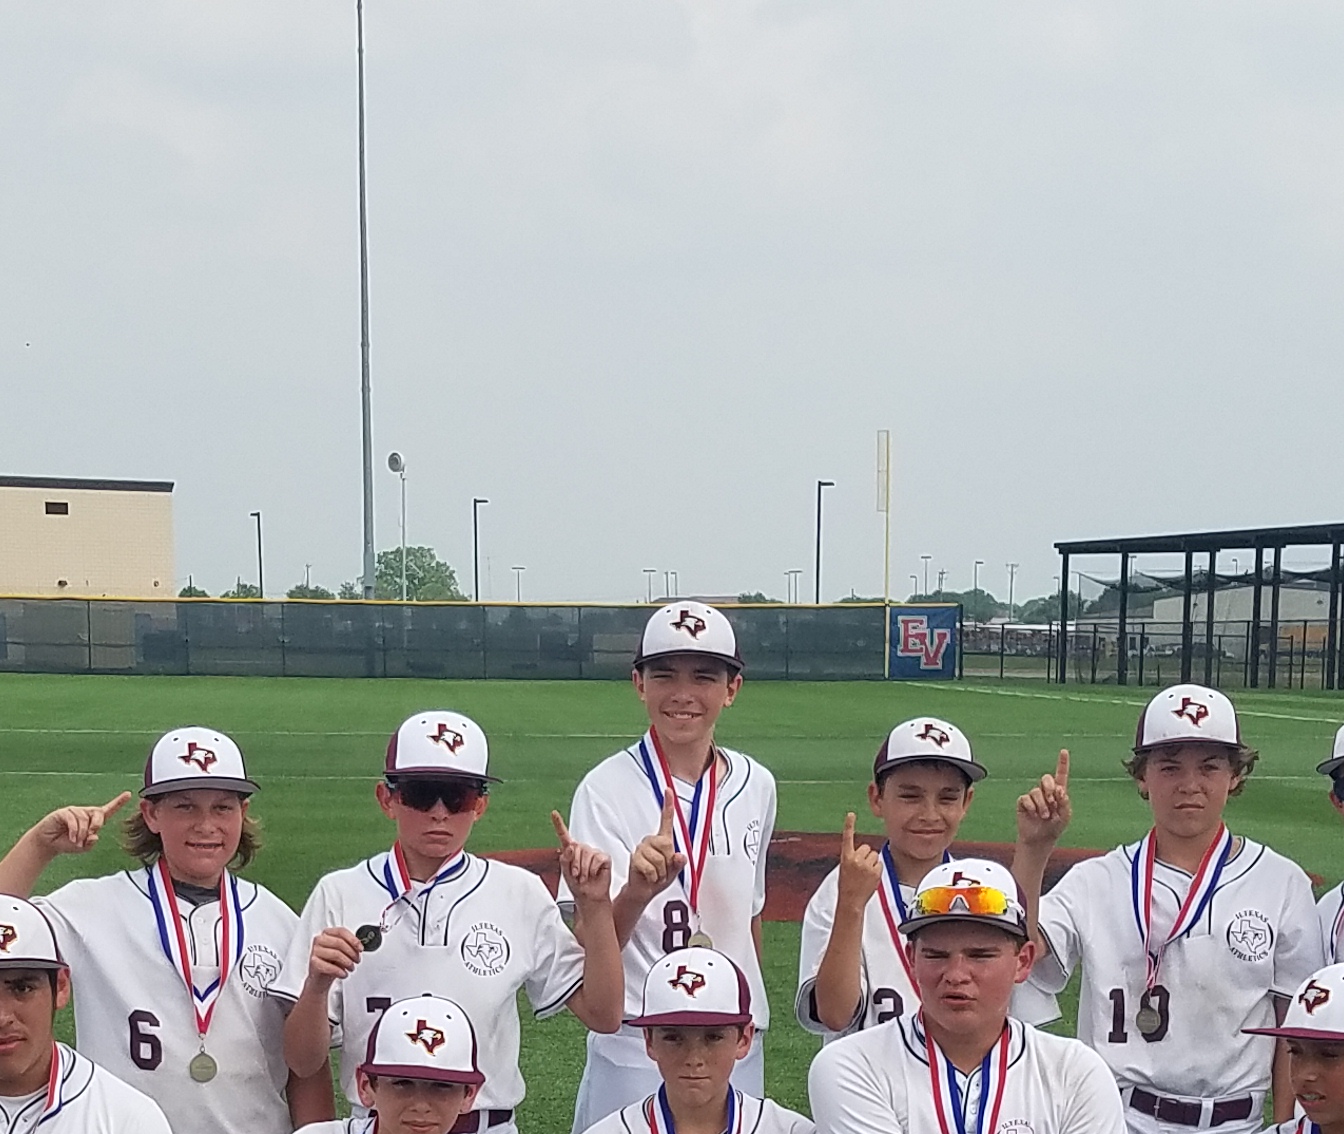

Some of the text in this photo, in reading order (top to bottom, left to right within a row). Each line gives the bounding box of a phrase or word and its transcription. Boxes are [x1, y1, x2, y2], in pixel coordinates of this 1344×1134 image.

[897, 615, 951, 670] EV
[662, 900, 691, 954] 8
[128, 1009, 163, 1071] 6
[1108, 984, 1170, 1043] 10
